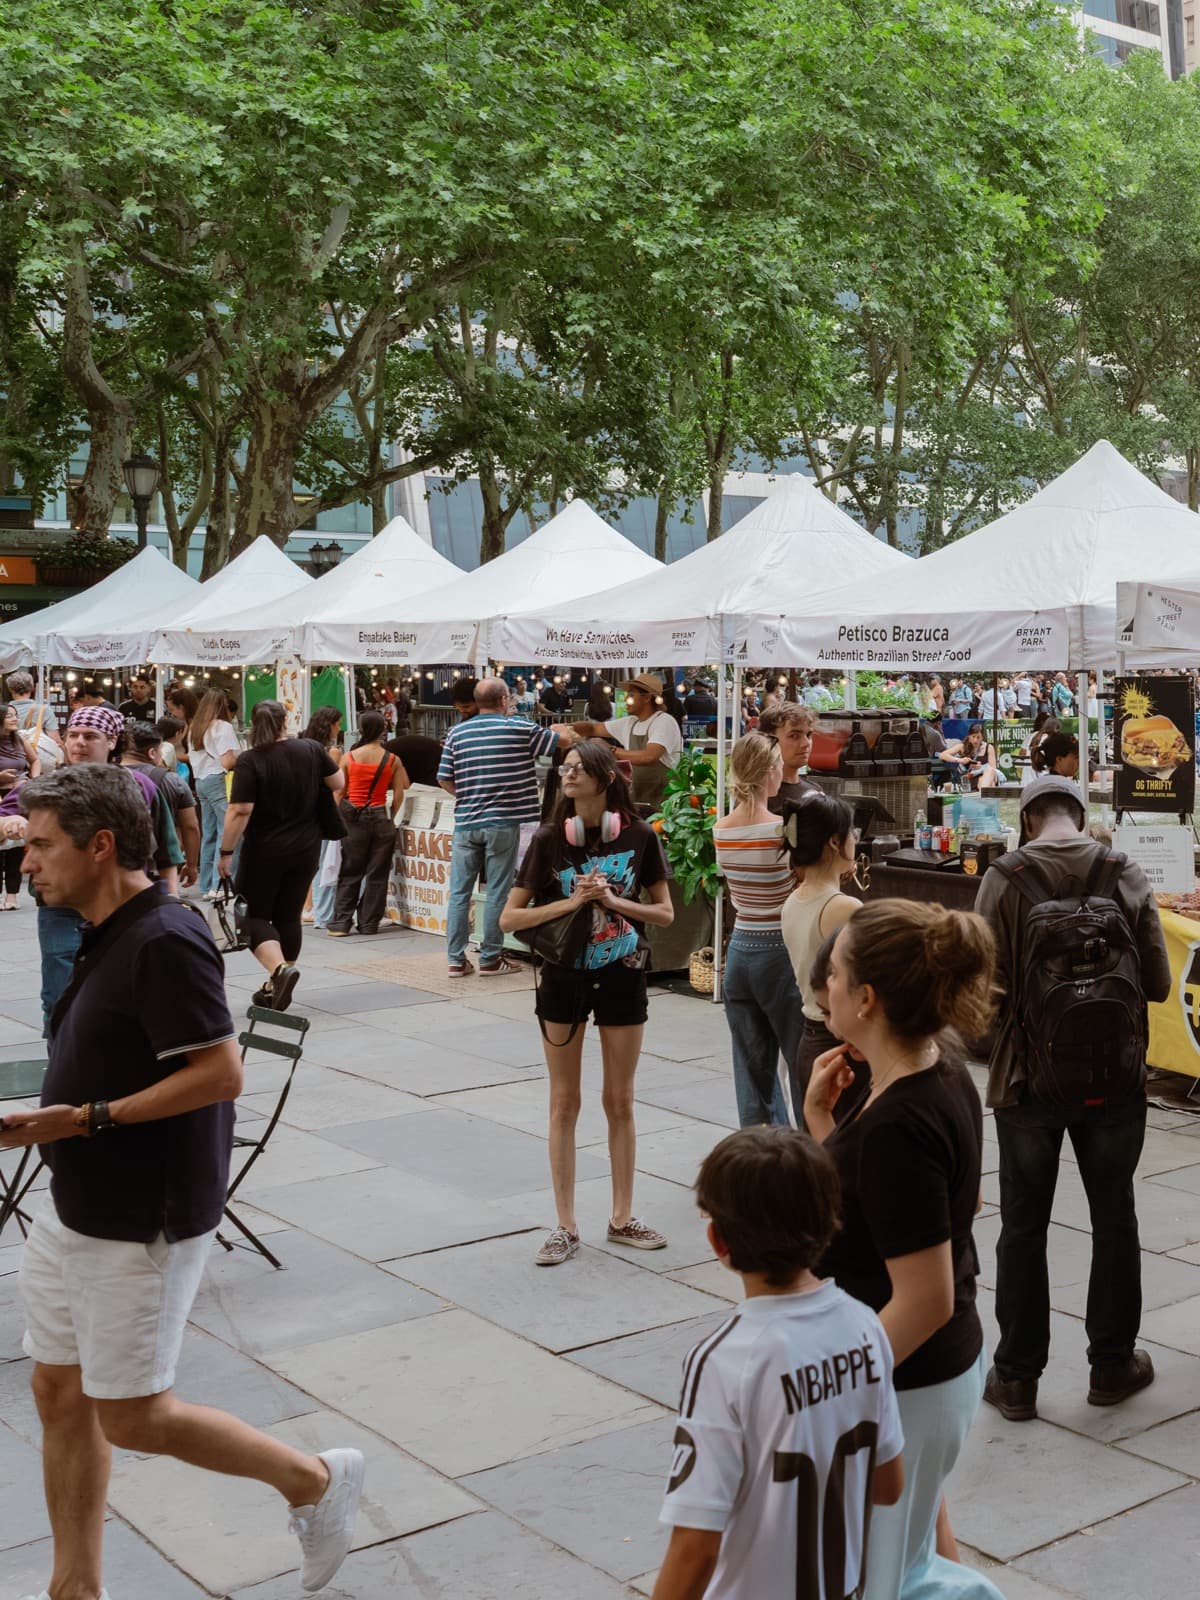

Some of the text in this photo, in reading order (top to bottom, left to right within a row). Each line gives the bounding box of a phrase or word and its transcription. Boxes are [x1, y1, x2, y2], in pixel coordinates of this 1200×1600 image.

[560, 630, 583, 643] Have
[838, 625, 949, 642] Petisco Brazuca
[1016, 627, 1052, 636] BRYANT
[394, 632, 418, 645] Bakery
[602, 650, 625, 660] Fresh
[627, 649, 649, 659] Juices
[817, 648, 972, 662] Authentic Brazilian Street Food
[1135, 780, 1172, 790] OG THRIFTY
[780, 1333, 880, 1415] MBAPPÉ
[773, 1420, 878, 1600] 10
